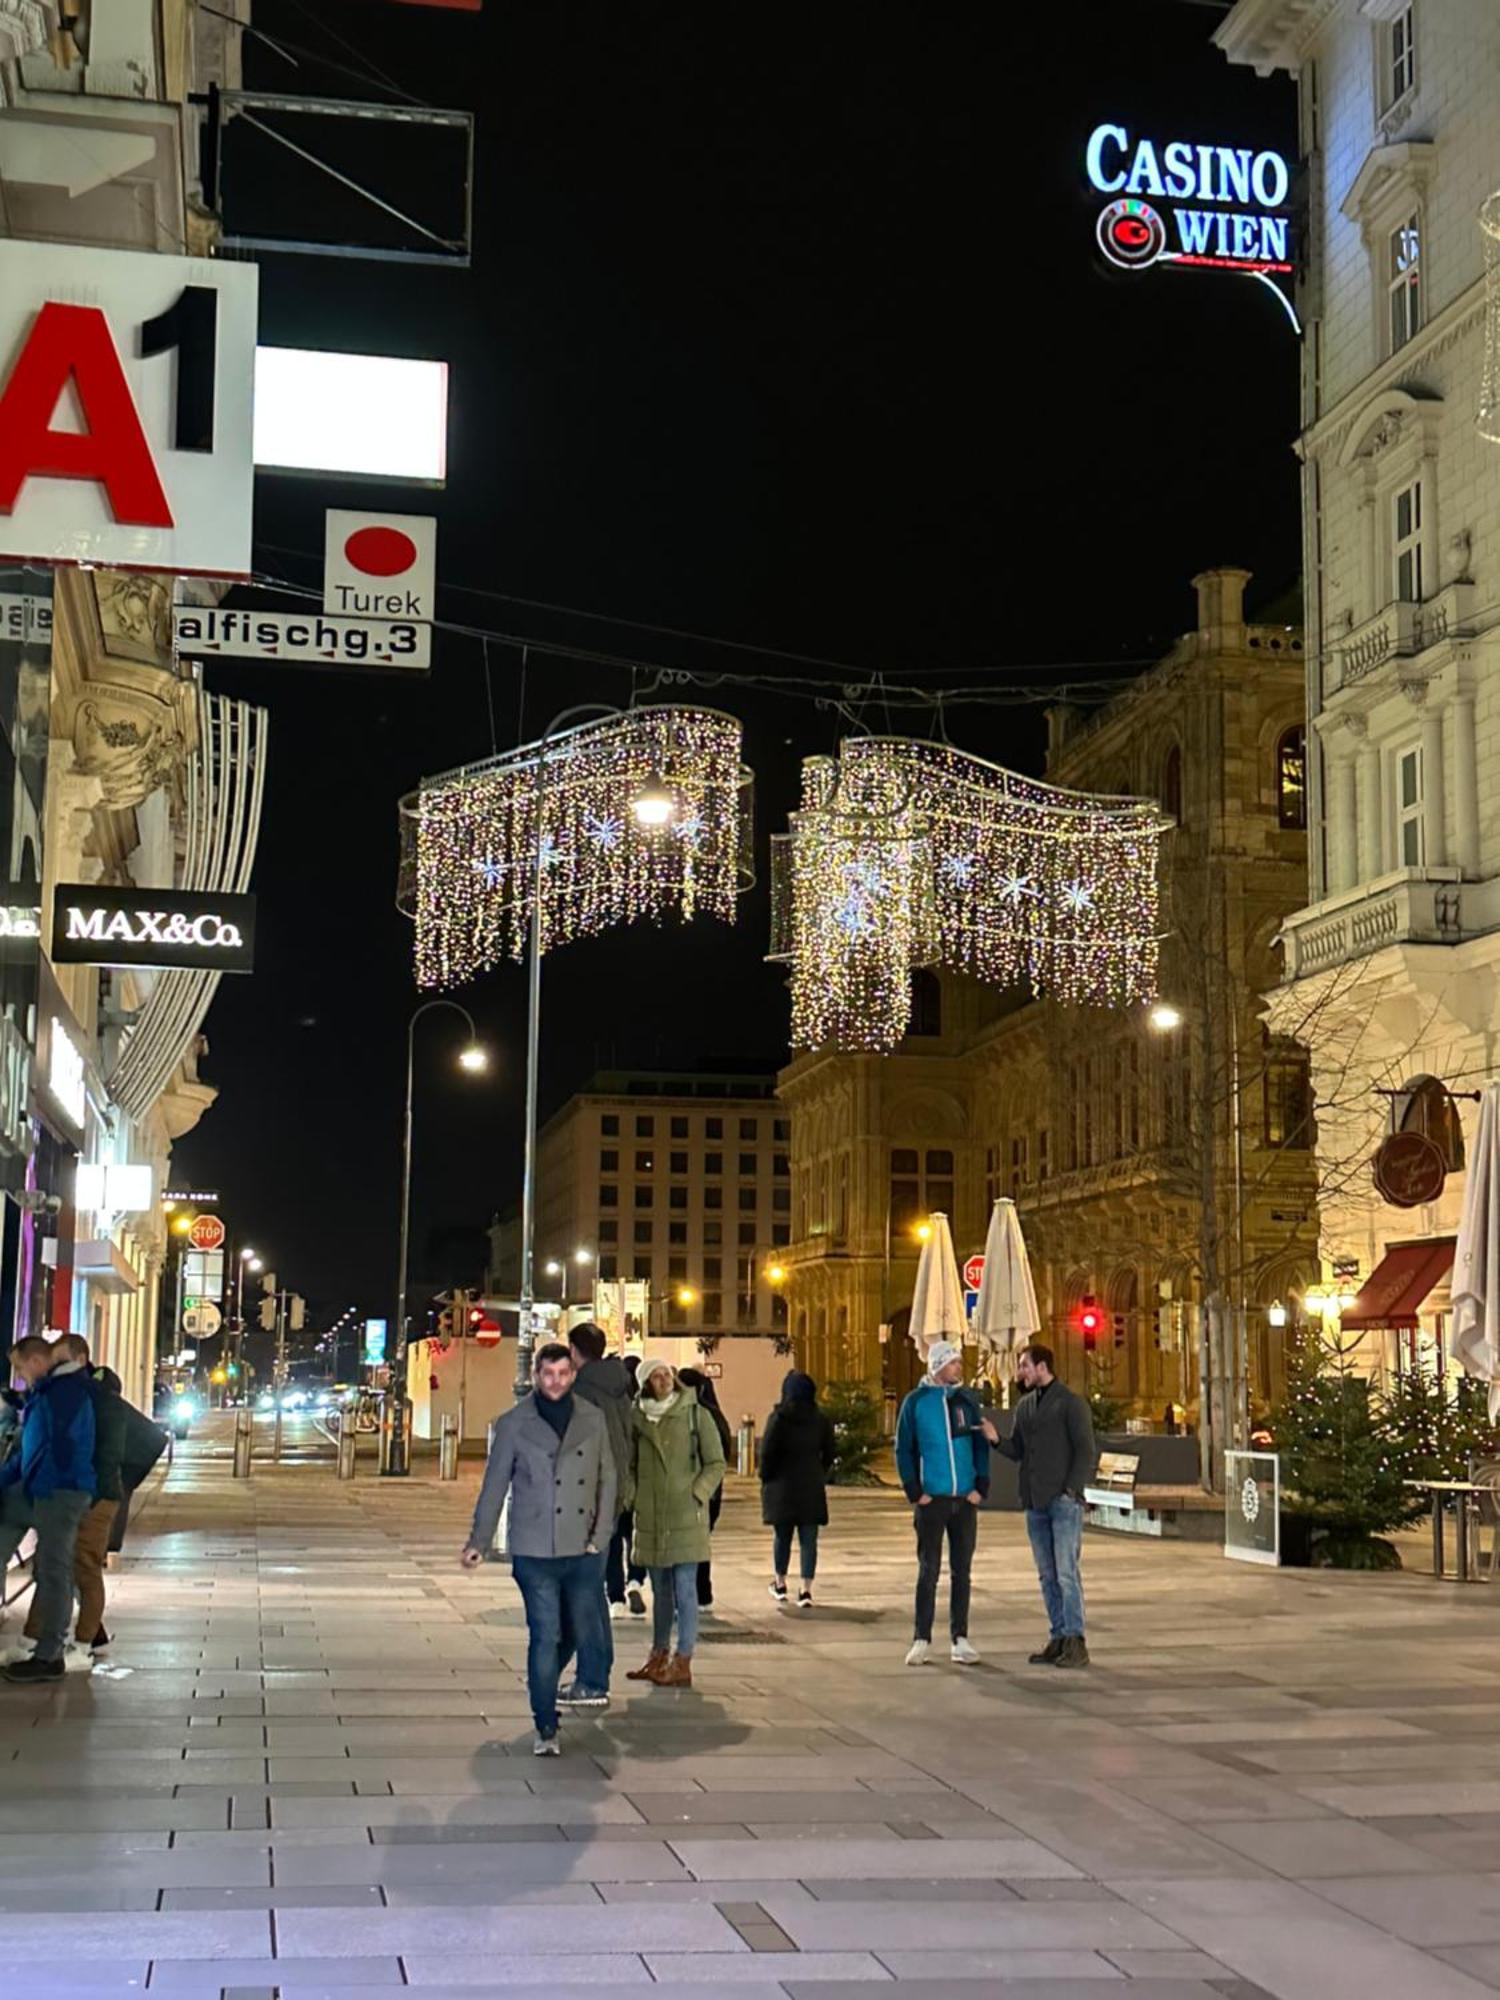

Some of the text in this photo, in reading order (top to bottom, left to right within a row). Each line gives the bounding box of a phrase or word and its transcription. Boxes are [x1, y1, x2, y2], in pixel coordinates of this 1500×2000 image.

[1173, 208, 1289, 261] WIEN
[0, 284, 218, 529] A1
[334, 584, 422, 616] Turek
[193, 1226, 221, 1240] STOP
